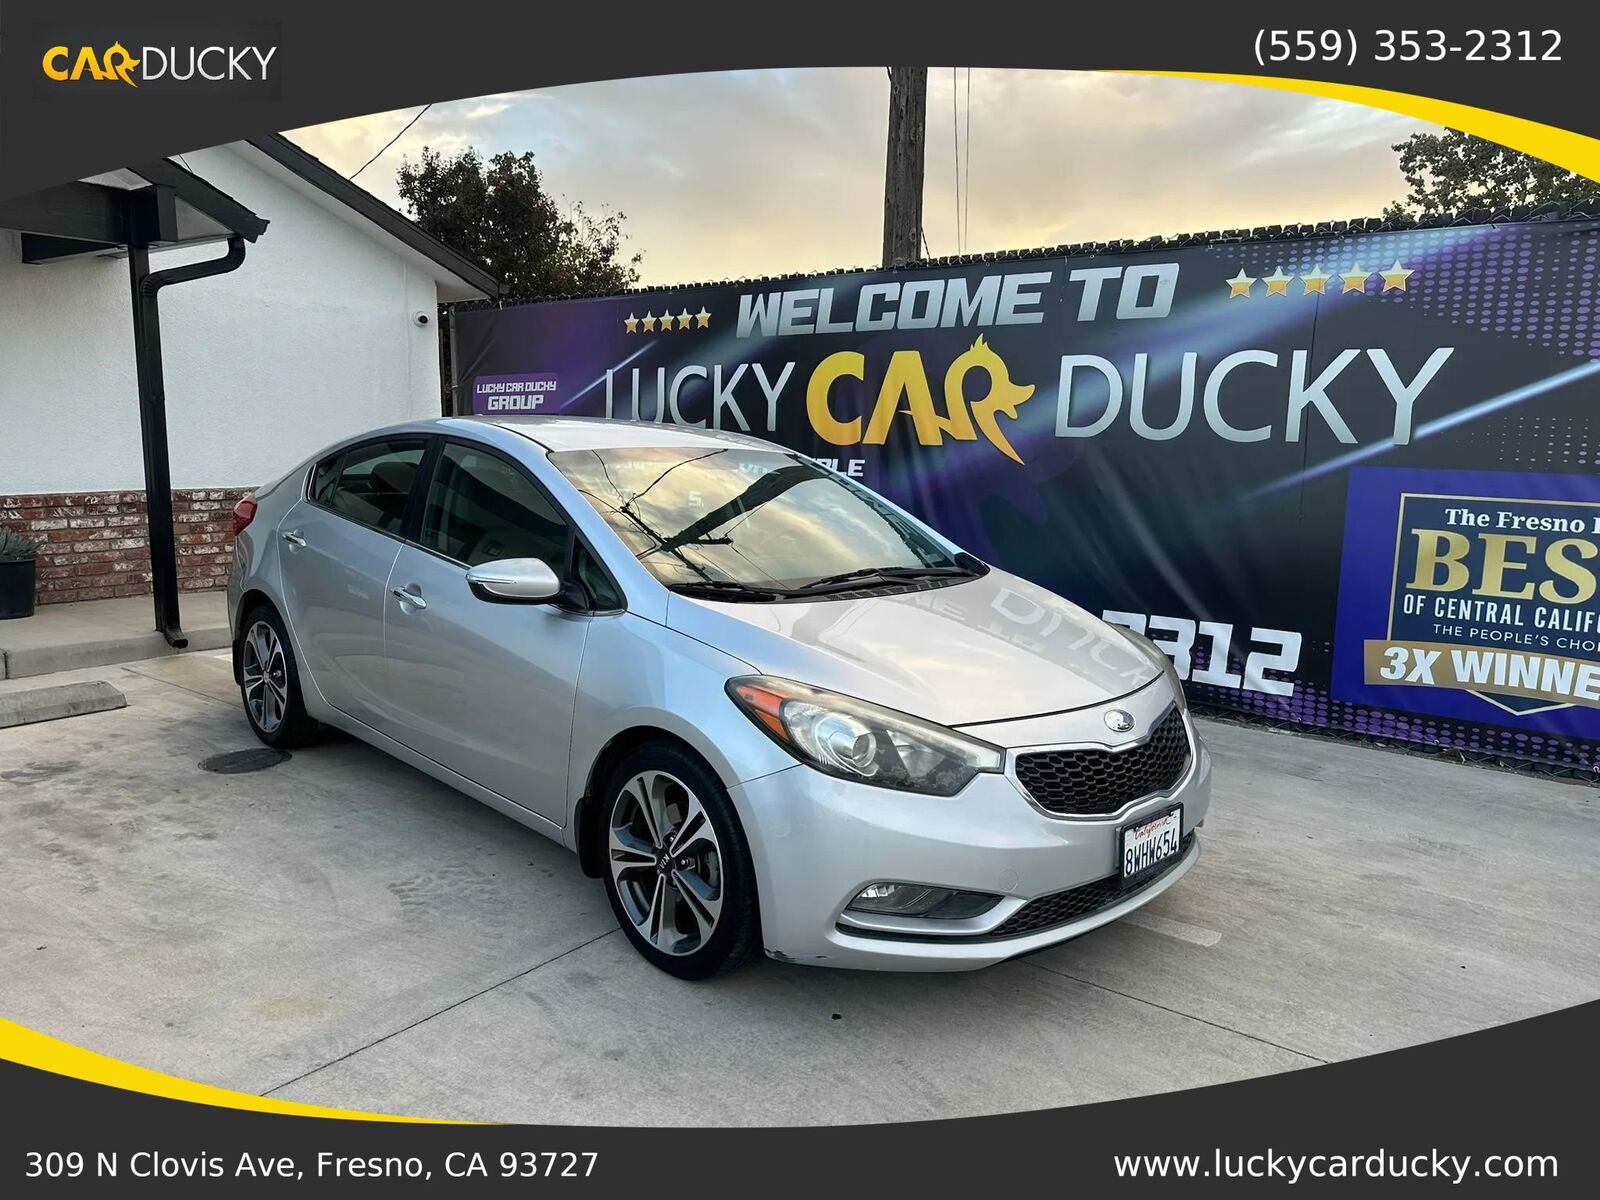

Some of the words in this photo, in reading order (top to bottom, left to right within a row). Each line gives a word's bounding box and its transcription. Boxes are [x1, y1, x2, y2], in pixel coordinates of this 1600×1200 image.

[736, 271, 1052, 338] WELCOME
[1069, 262, 1180, 321] TO
[476, 383, 505, 394] LUCKY
[505, 382, 525, 393] CAR
[525, 381, 557, 392] DUCKY
[487, 395, 544, 410] GROUP
[806, 333, 1036, 466] CAR
[1055, 347, 1455, 446] DUCKY
[1445, 508, 1490, 528] The
[1495, 511, 1585, 534] Fresno
[1405, 528, 1600, 605] BES
[1403, 593, 1427, 616] OF
[1434, 596, 1525, 627] CENTRAL
[1534, 606, 1600, 635] CALIF
[1433, 624, 1463, 638] THE
[1469, 628, 1550, 647] PEOPLE'S
[1380, 646, 1442, 685] 3X
[1125, 827, 1177, 876] 8WHW654
